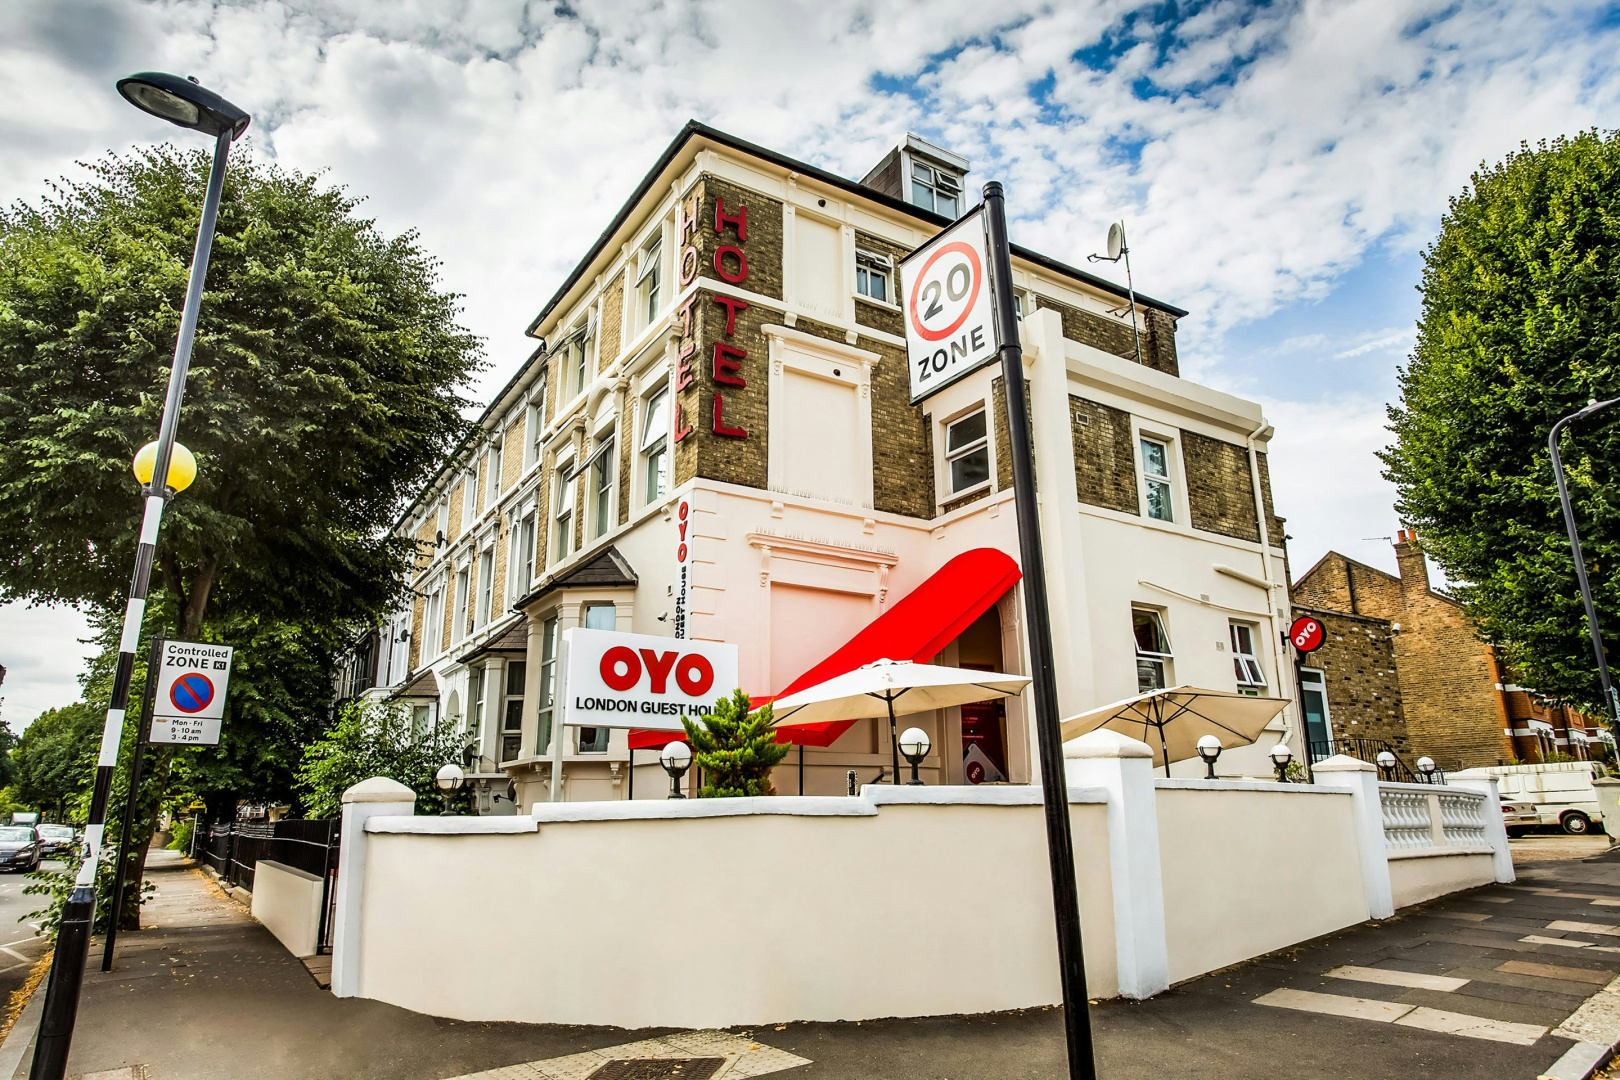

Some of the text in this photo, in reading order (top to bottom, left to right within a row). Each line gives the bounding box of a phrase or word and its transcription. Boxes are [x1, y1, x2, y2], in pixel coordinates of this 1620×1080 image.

[712, 196, 748, 439] HOTEL
[921, 262, 971, 322] 20
[674, 196, 699, 443] HOTEL
[917, 324, 986, 383] ZONE
[678, 501, 688, 563] OYO
[168, 645, 228, 658] Controlled
[1296, 622, 1317, 646] OYO
[166, 656, 209, 669] ZONE
[600, 646, 714, 696] OYO
[575, 696, 717, 716] LONDON GUEST HOU
